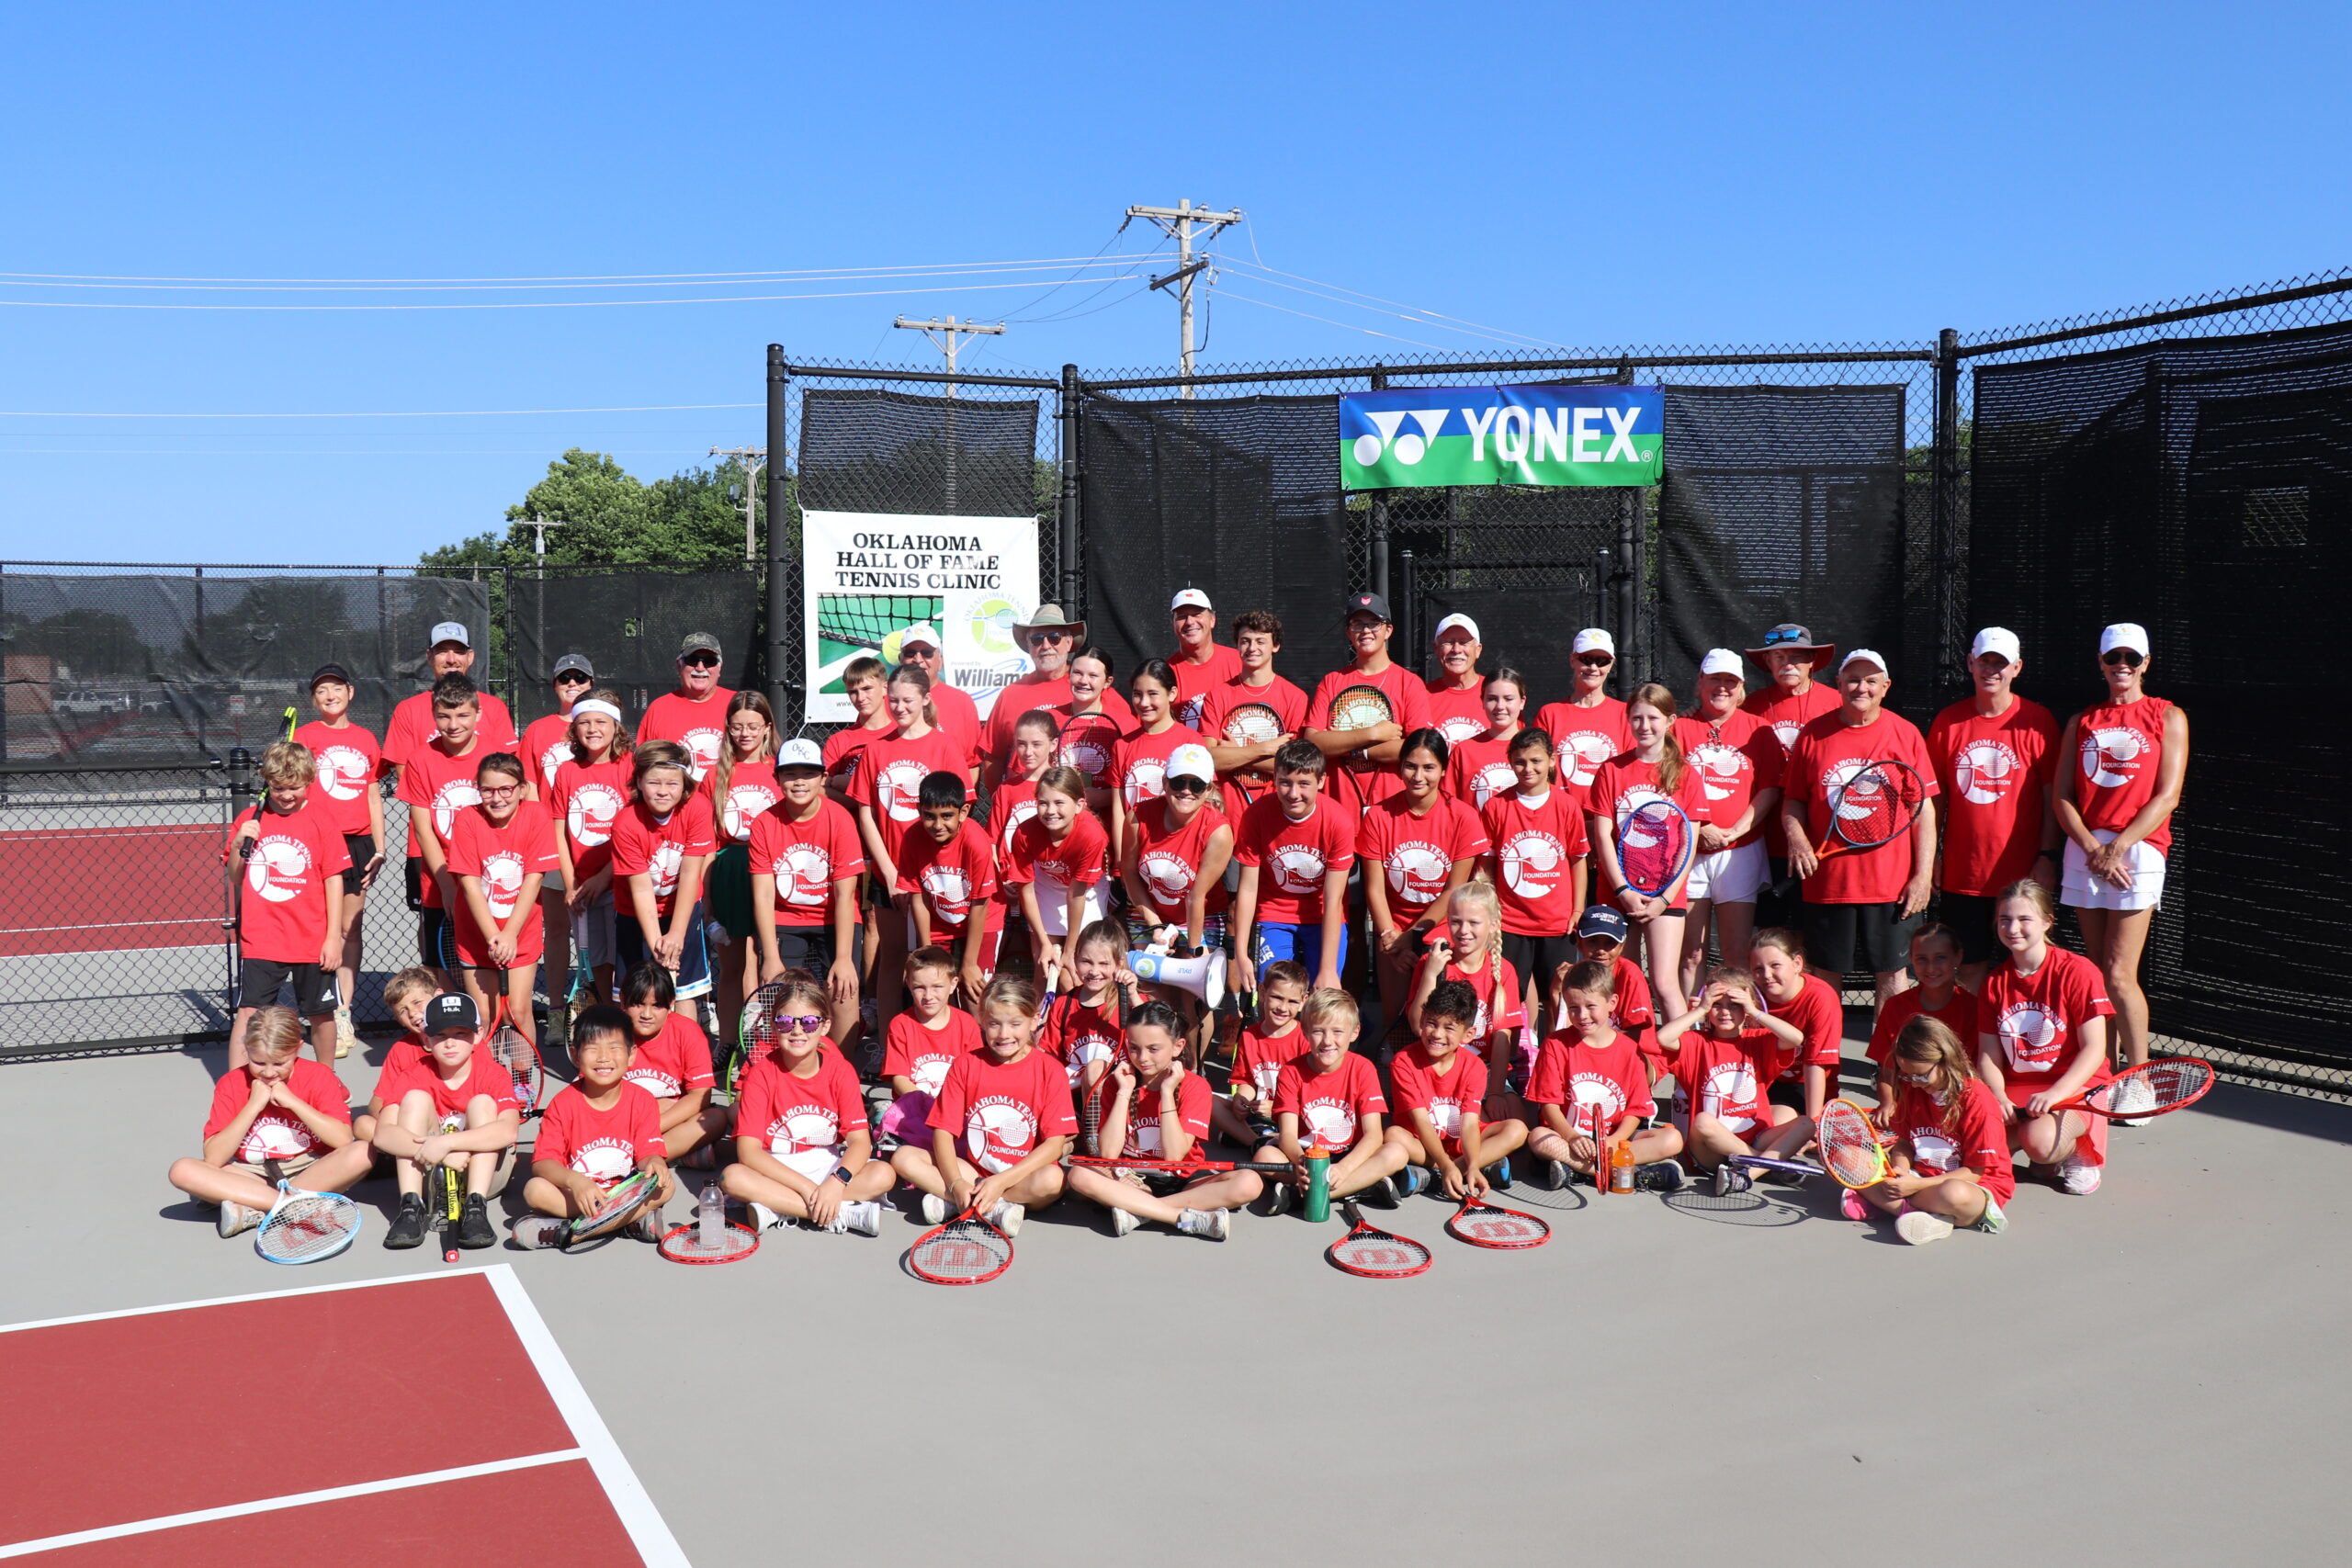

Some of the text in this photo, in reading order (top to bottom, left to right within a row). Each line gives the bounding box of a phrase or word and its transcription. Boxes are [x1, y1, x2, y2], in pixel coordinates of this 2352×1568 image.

[1461, 405, 1642, 463] YONEX
[853, 533, 982, 551] OKLAHOMA
[836, 552, 1000, 571] HALL OF FAME
[835, 571, 1001, 591] TENNIS CLINIC
[1557, 729, 1598, 755] OKLAHOMA
[792, 743, 810, 761] OKC
[1996, 740, 2020, 770] TENNIS
[1705, 775, 1740, 784] FOUNDATION
[1822, 758, 1866, 785] OKLAHOMA
[1499, 829, 1543, 862] OKLAHOMA
[1408, 880, 1446, 888] FOUNDATION
[1523, 871, 1561, 879] FOUNDATION
[2018, 1043, 2063, 1058] FOUNDATION
